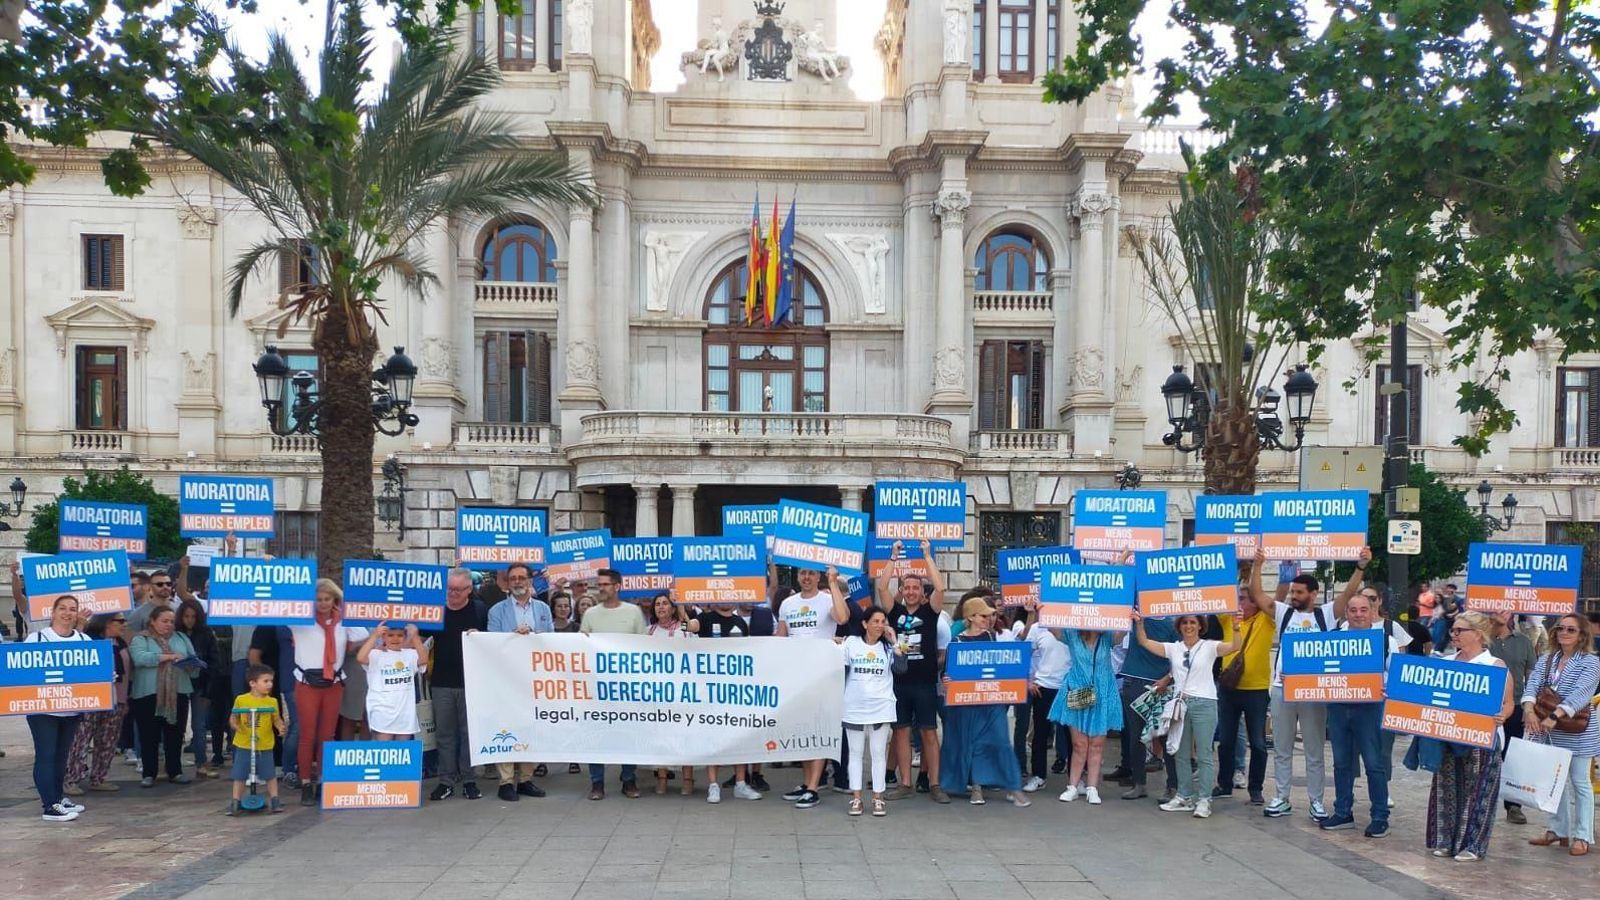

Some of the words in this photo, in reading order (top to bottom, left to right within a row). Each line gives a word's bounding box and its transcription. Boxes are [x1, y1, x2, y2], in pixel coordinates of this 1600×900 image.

[185, 482, 270, 501] MORATORIA
[880, 488, 961, 507] MORATORIA
[1085, 497, 1155, 513] MORATORIA
[1206, 503, 1261, 519] MORATO
[1274, 499, 1356, 517] MORATORIA
[64, 506, 143, 525] MORATORIA
[184, 516, 224, 529] MENOS
[228, 516, 270, 530] EMPLEO
[462, 514, 541, 533] MORATORIA
[726, 509, 778, 525] MORATOR
[782, 506, 863, 536] MORATORIA
[877, 524, 914, 538] MENOS
[918, 524, 961, 538] EMPLEO
[1105, 529, 1132, 538] MENOS
[62, 536, 100, 550] MENOS
[551, 536, 604, 553] MORATORIA
[1083, 538, 1112, 548] OFERTA
[1297, 535, 1328, 546] MENOS
[462, 548, 497, 561] MENOS
[501, 549, 541, 561] EMPLEO
[683, 544, 757, 561] MORATORIA
[775, 539, 817, 559] MENOS
[821, 548, 860, 567] EMPLEO
[1264, 547, 1309, 558] SERVICIOS
[36, 558, 117, 580] MORATORIA
[1007, 553, 1071, 571] MORATORIA
[1147, 552, 1225, 574] MORATORIA
[1480, 552, 1568, 571] MORATORIA
[215, 564, 311, 584] MORATORIA
[349, 567, 442, 589] MORATORIA
[1051, 571, 1124, 590] MORATORIA
[621, 577, 648, 589] ENOS
[652, 577, 673, 589] EMP
[706, 579, 735, 589] MENOS
[685, 590, 714, 600] OFERTA
[1172, 589, 1202, 601] MENOS
[1504, 588, 1538, 600] MENOS
[211, 601, 257, 616] MENOS
[261, 602, 311, 617] EMPLEO
[345, 604, 388, 619] MENOS
[393, 605, 440, 621] EMPLEO
[1071, 605, 1099, 617] MENOS
[1150, 602, 1181, 614] OFERTA
[1468, 599, 1515, 610] SERVICIOS
[1040, 615, 1081, 627] SERVICIOS
[1293, 638, 1372, 658] MORATORIA
[7, 649, 100, 669] MORATORIA
[532, 651, 566, 673] POR
[571, 652, 591, 674] EL
[596, 652, 675, 675] DERECHO
[680, 653, 691, 675] A
[696, 653, 754, 677] ELEGIR
[957, 649, 1021, 665] MORATORIA
[854, 667, 884, 675] RESPECT
[974, 681, 1000, 691] MENOS
[1317, 676, 1347, 687] MENOS
[1401, 664, 1490, 695] MORATORIA
[37, 686, 73, 698] MENOS
[533, 680, 567, 700] POR
[572, 680, 593, 700] EL
[597, 681, 675, 703] DERECHO
[680, 682, 702, 704] AL
[706, 682, 779, 708] TURISMO
[954, 692, 982, 702] OFERTA
[1294, 688, 1326, 699] OFERTA
[9, 699, 47, 712] OFERTA
[535, 707, 580, 724] legal,
[584, 707, 682, 724] responsable
[685, 711, 695, 726] y
[699, 710, 777, 728] sostenible
[1421, 707, 1456, 724] MENOS
[1385, 714, 1431, 733] SERVICIOS
[1434, 722, 1492, 744] TURÍSTICOS
[481, 743, 529, 755] ApturCV
[779, 734, 839, 750] viutur
[335, 748, 411, 766] MORATORIA
[357, 783, 386, 794] MENOS
[333, 795, 365, 806] OFERTA
